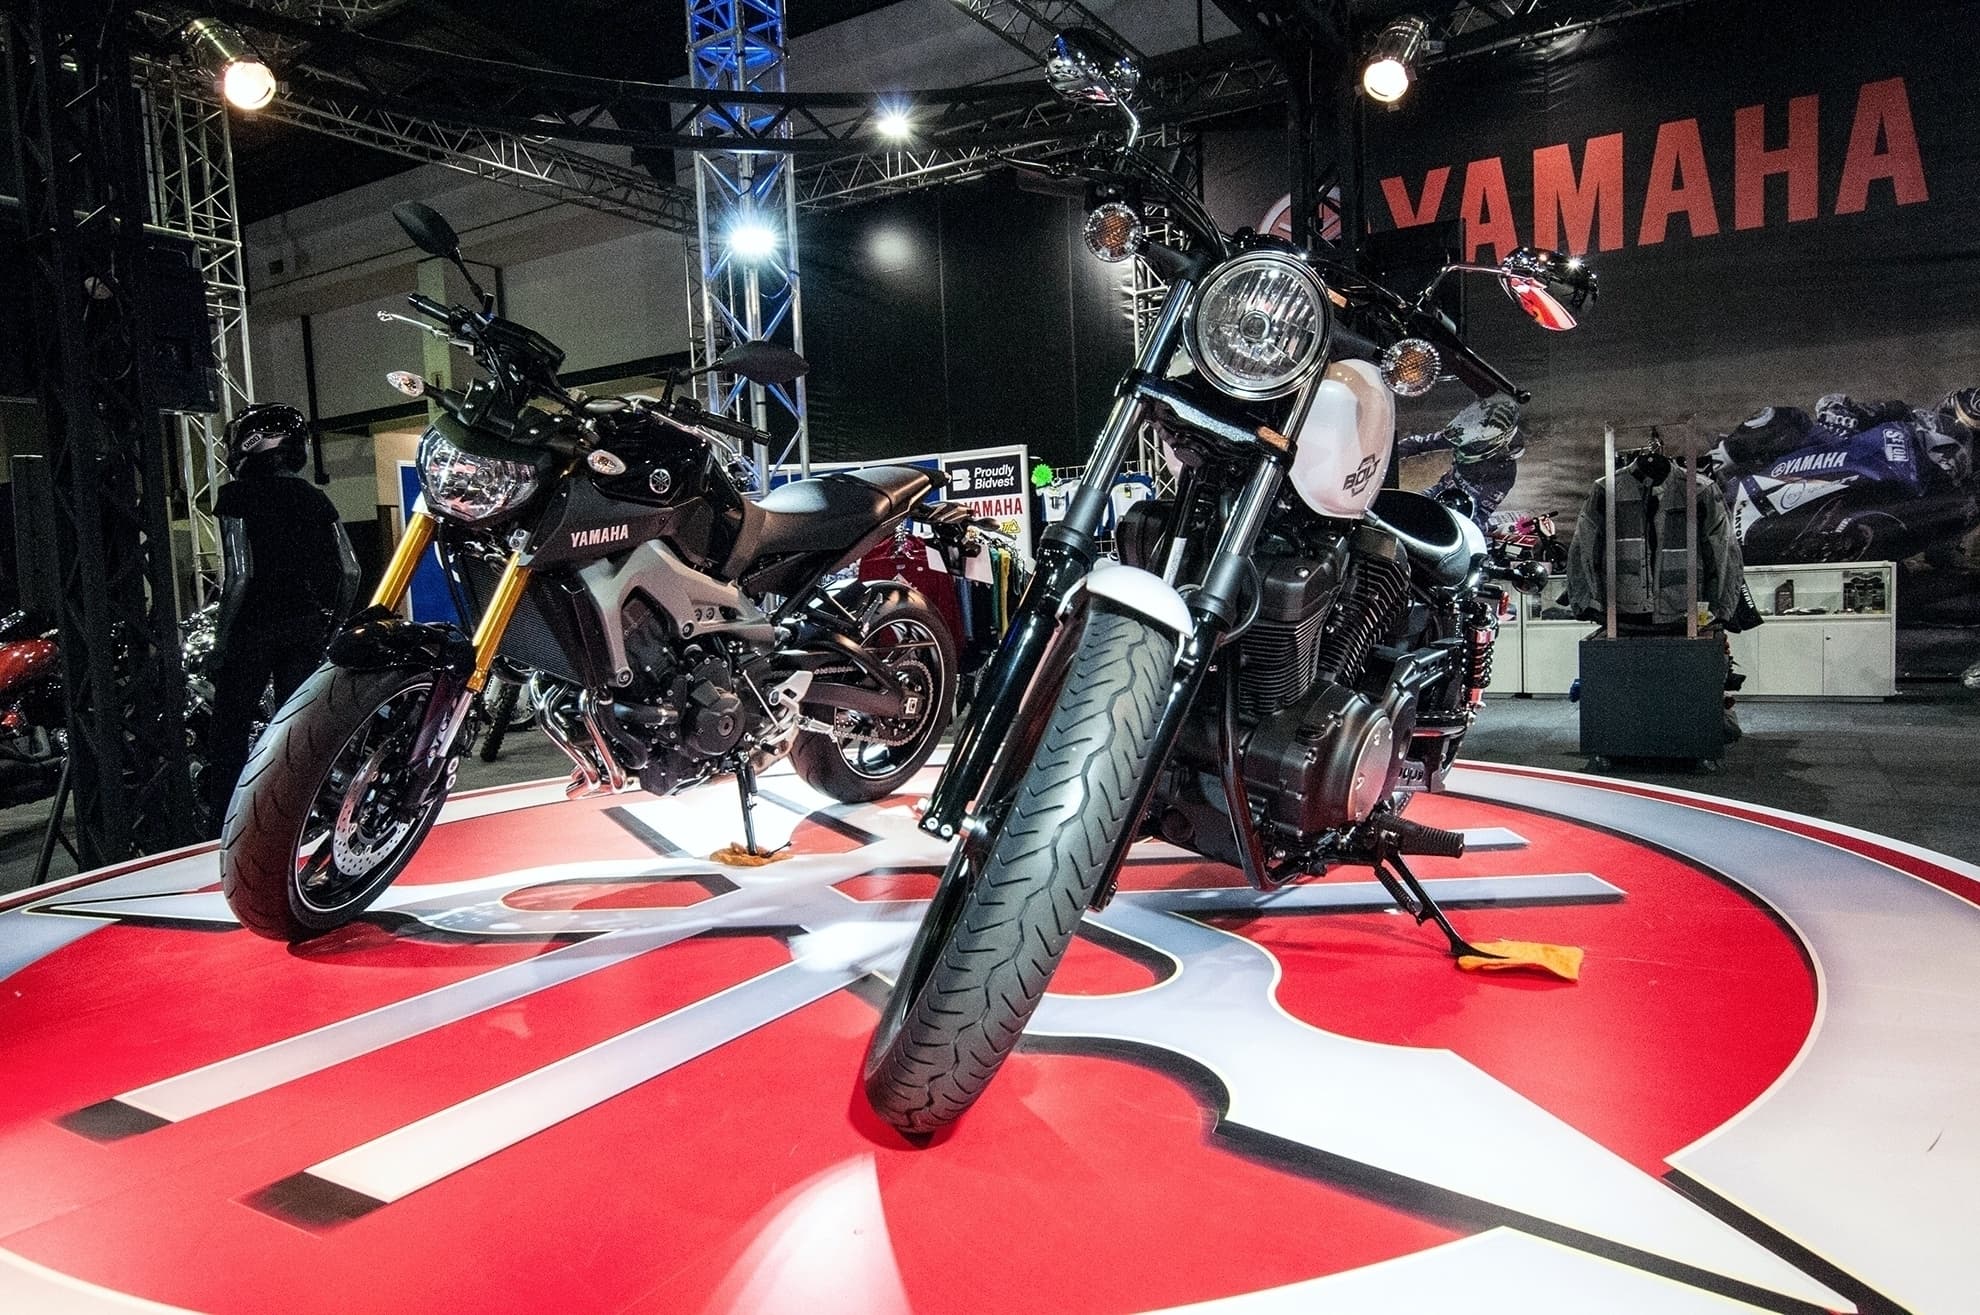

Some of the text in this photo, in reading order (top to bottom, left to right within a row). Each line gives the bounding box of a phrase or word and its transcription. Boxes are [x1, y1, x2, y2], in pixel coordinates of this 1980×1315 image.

[1380, 76, 1929, 265] YAMAHA
[974, 464, 1015, 478] Proudly
[1783, 451, 1848, 475] YAMAHA
[974, 476, 1014, 490] Bidvest
[570, 524, 629, 548] YAMAHA
